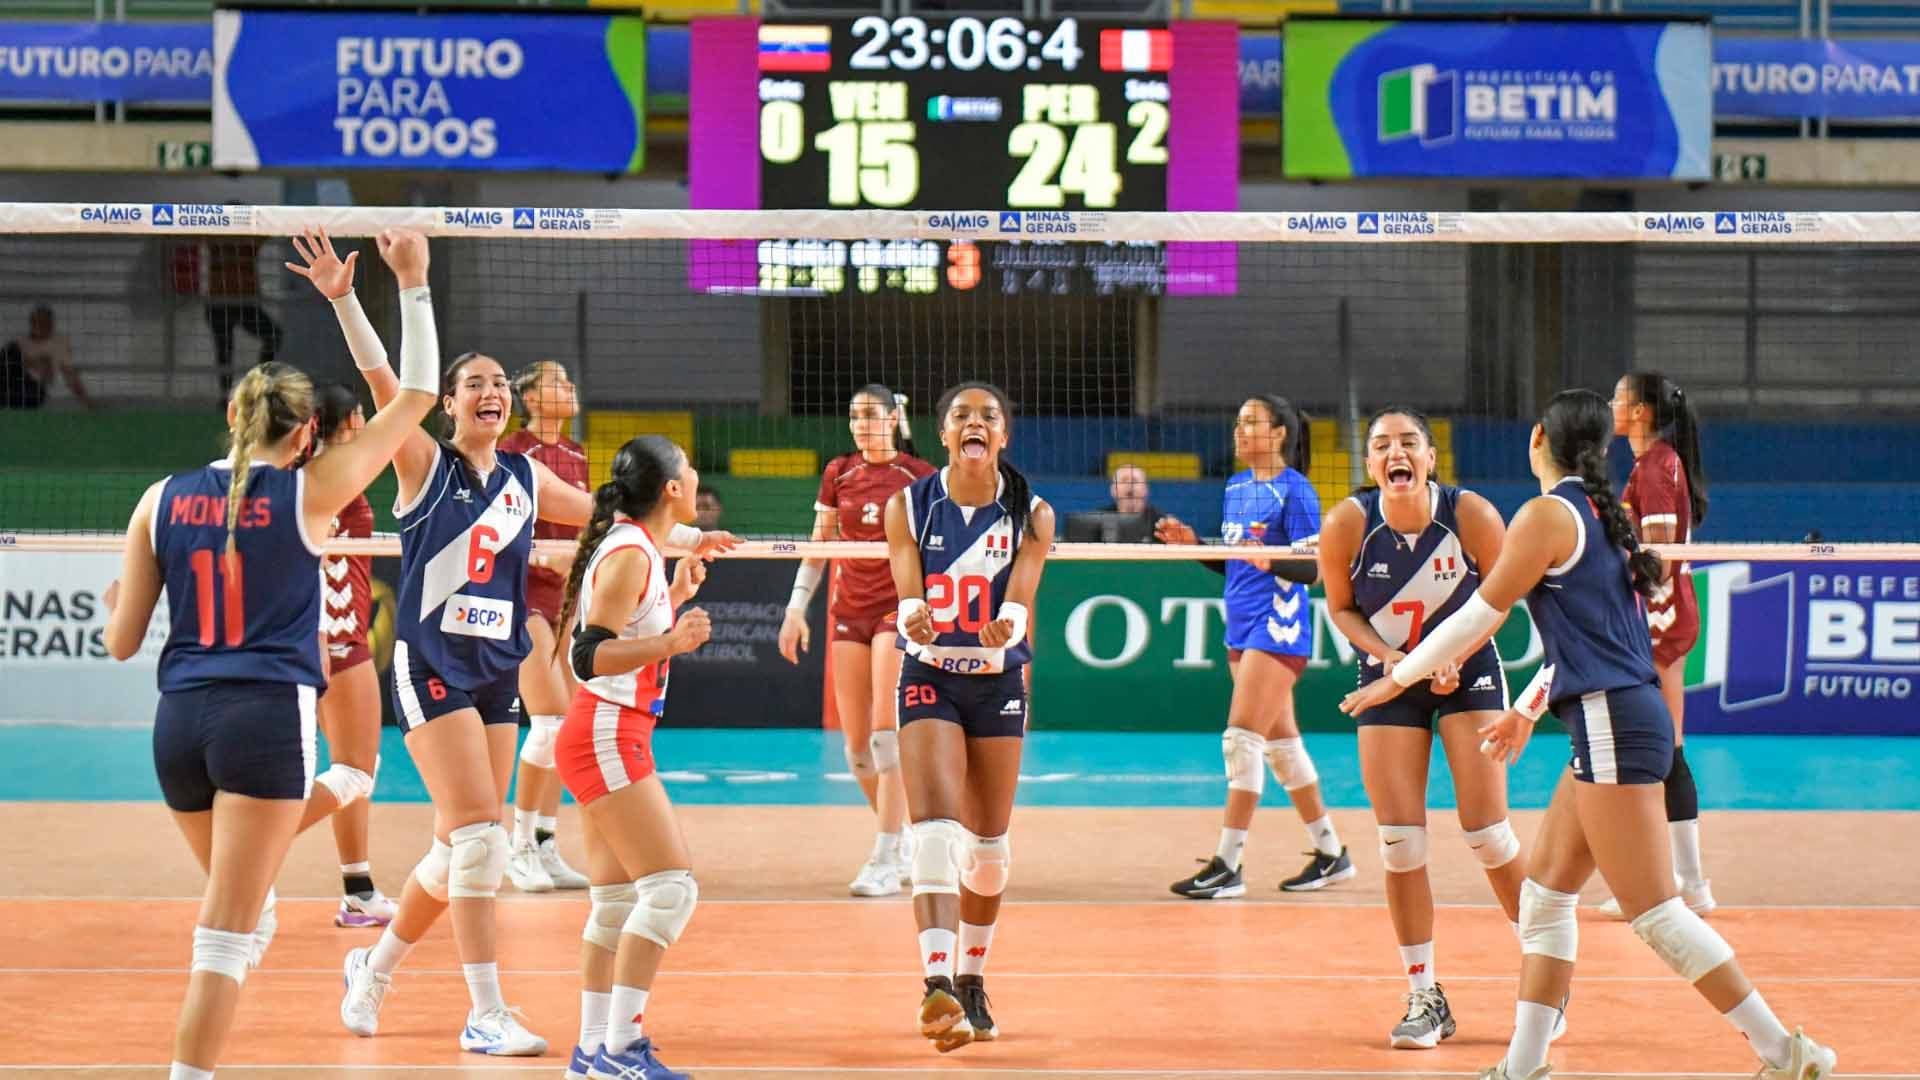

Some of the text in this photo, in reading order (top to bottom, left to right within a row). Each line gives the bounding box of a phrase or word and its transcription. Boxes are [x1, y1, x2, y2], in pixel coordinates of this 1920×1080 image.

[850, 16, 1083, 71] 23:06:4
[133, 48, 213, 77] PARA
[336, 38, 523, 78] FUTURO
[1822, 64, 1902, 93] PARA
[338, 79, 450, 116] PARA
[829, 81, 908, 120] VEN
[1023, 84, 1099, 121] PER
[1465, 85, 1616, 121] BETIM
[335, 118, 497, 158] TODOS
[760, 101, 804, 164] 0
[1127, 100, 1169, 164] 2
[814, 121, 919, 206] 15
[1007, 122, 1117, 208] 24
[80, 205, 142, 224] GASMIG
[178, 204, 223, 214] MINAS
[178, 215, 230, 226] GERAIS
[540, 208, 584, 218] MINAS
[1026, 211, 1070, 221] MINAS
[1384, 212, 1428, 222] MINAS
[1741, 212, 1785, 222] MINAS
[540, 220, 591, 230] GERAIS
[928, 213, 989, 231] GASMIG
[1026, 223, 1076, 233] GERAIS
[1287, 214, 1347, 233] GASMIG
[1384, 224, 1434, 234] GERAIS
[1644, 214, 1705, 232] GASMIG
[1741, 223, 1792, 234] GERAIS
[170, 495, 271, 528] MONES
[861, 502, 879, 525] 2
[467, 525, 499, 584] 6
[985, 550, 1008, 558] PER
[1434, 571, 1457, 581] PER
[1809, 574, 1920, 599] PREFE
[190, 549, 243, 647] 11
[925, 573, 992, 633] 20
[467, 607, 497, 627] BCP
[1392, 600, 1424, 652] 7
[1807, 599, 1920, 661] BE
[942, 657, 981, 673] BCP
[428, 677, 447, 700] 6
[905, 684, 937, 707] 20
[1804, 675, 1911, 699] FUTURO
